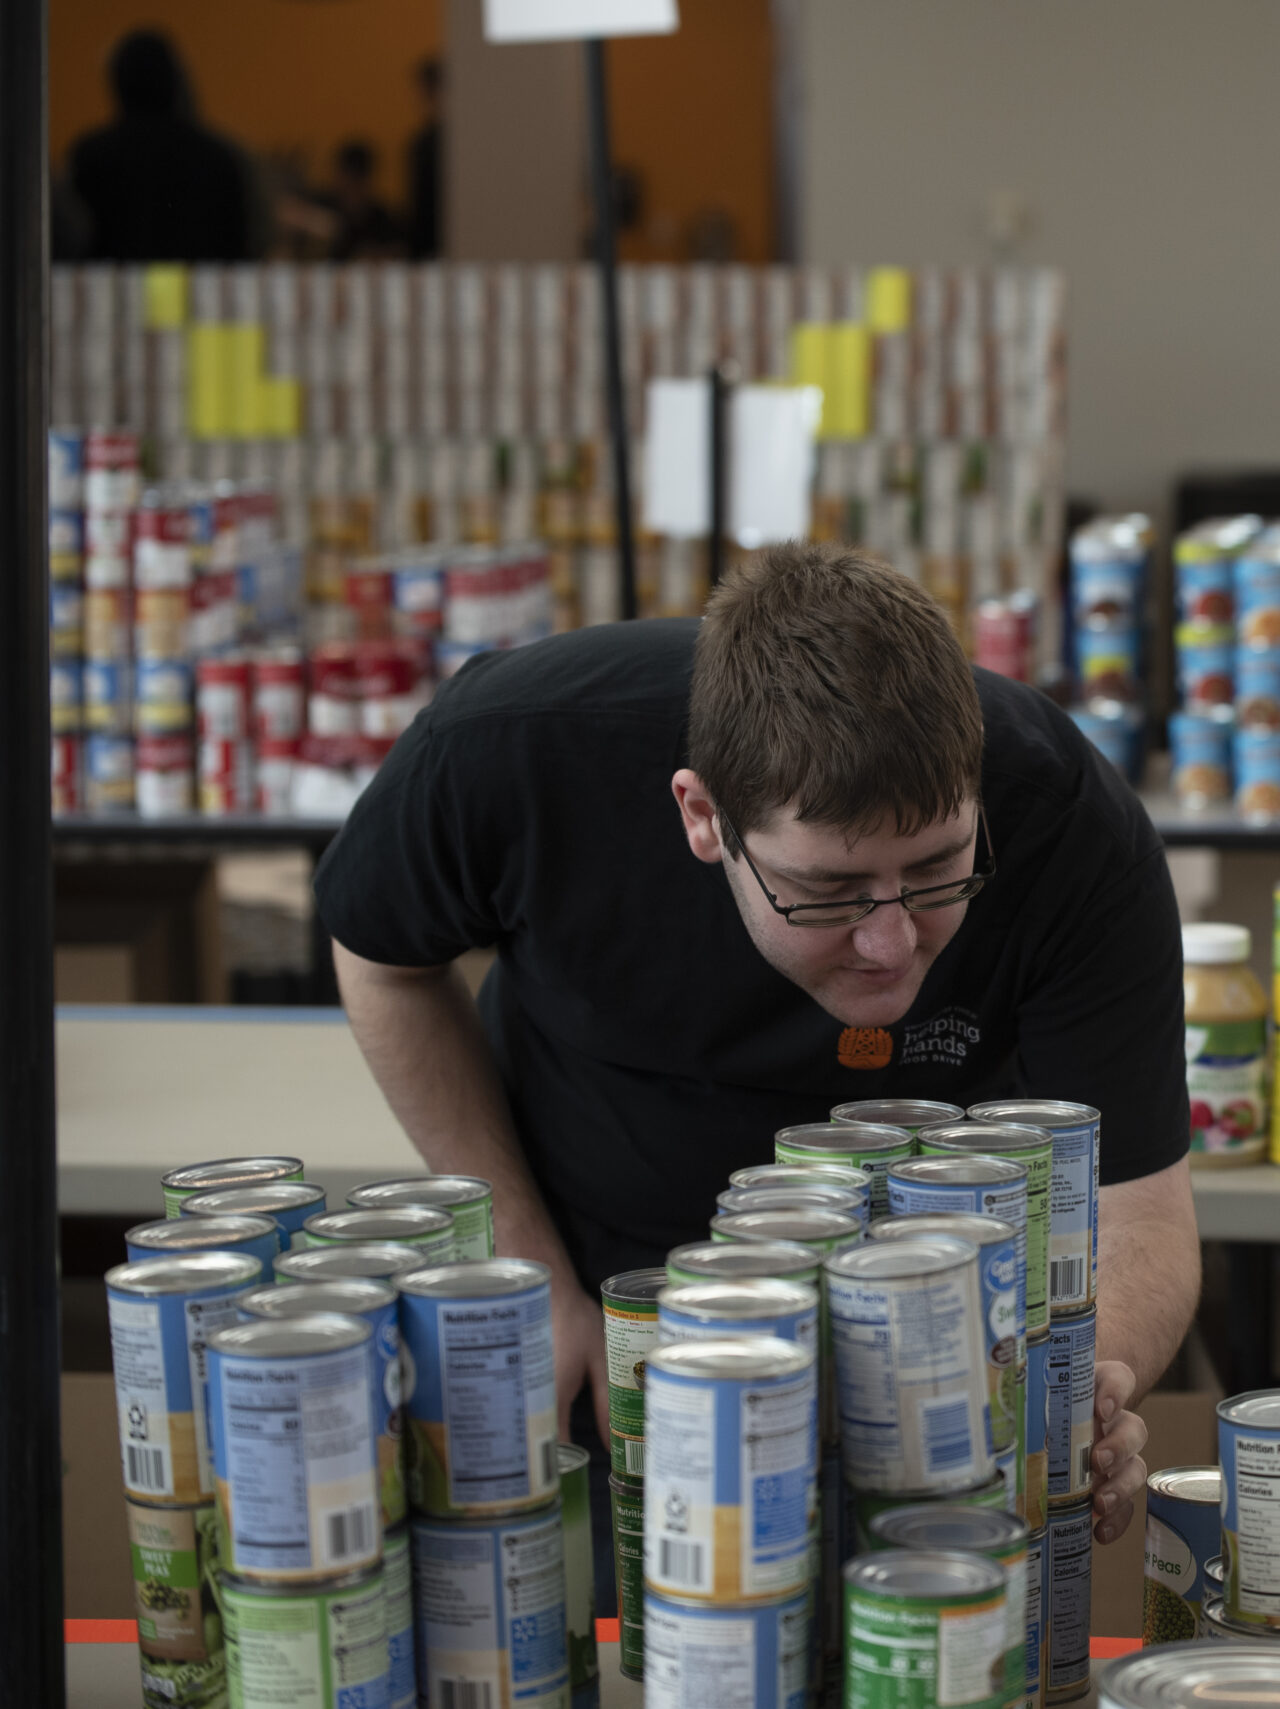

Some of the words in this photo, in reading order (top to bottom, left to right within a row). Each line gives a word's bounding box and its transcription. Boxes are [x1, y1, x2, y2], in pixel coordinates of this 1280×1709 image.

[932, 1054, 962, 1066] DRIVE
[1050, 1334, 1071, 1345] Facts
[1058, 1371, 1070, 1383] 60
[1238, 1440, 1274, 1454] Nutrition
[1238, 1484, 1273, 1497] Calories
[617, 1505, 646, 1518] Nutritio
[1054, 1524, 1083, 1538] Nutrition
[1055, 1566, 1079, 1577] Calories
[1152, 1554, 1181, 1576] Peas
